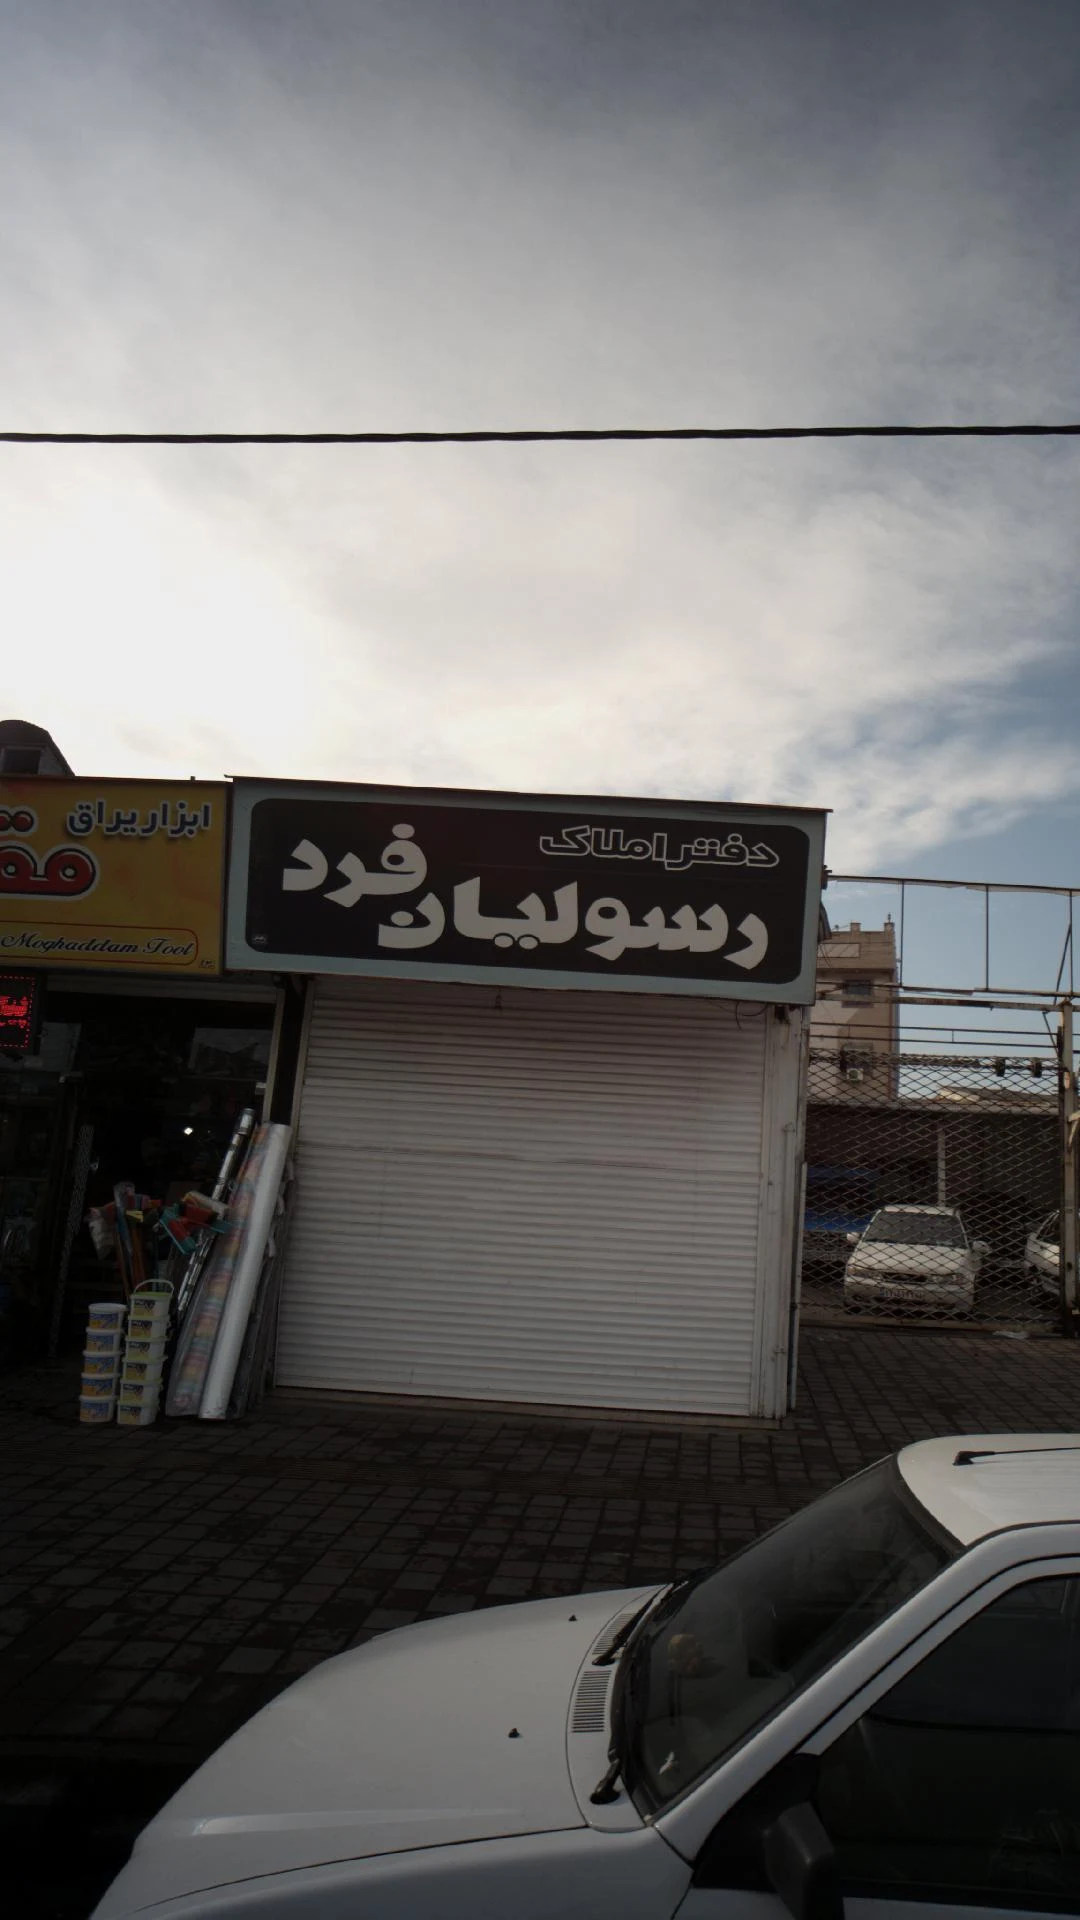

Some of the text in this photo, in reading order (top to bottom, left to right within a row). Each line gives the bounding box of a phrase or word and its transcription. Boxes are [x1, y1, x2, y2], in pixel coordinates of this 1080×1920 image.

[67, 799, 211, 837] ابزار یراق
[540, 825, 780, 871] دفتر املاک
[282, 824, 769, 970] رسولیان فرد
[0, 932, 194, 957] Moghaddam Tool
